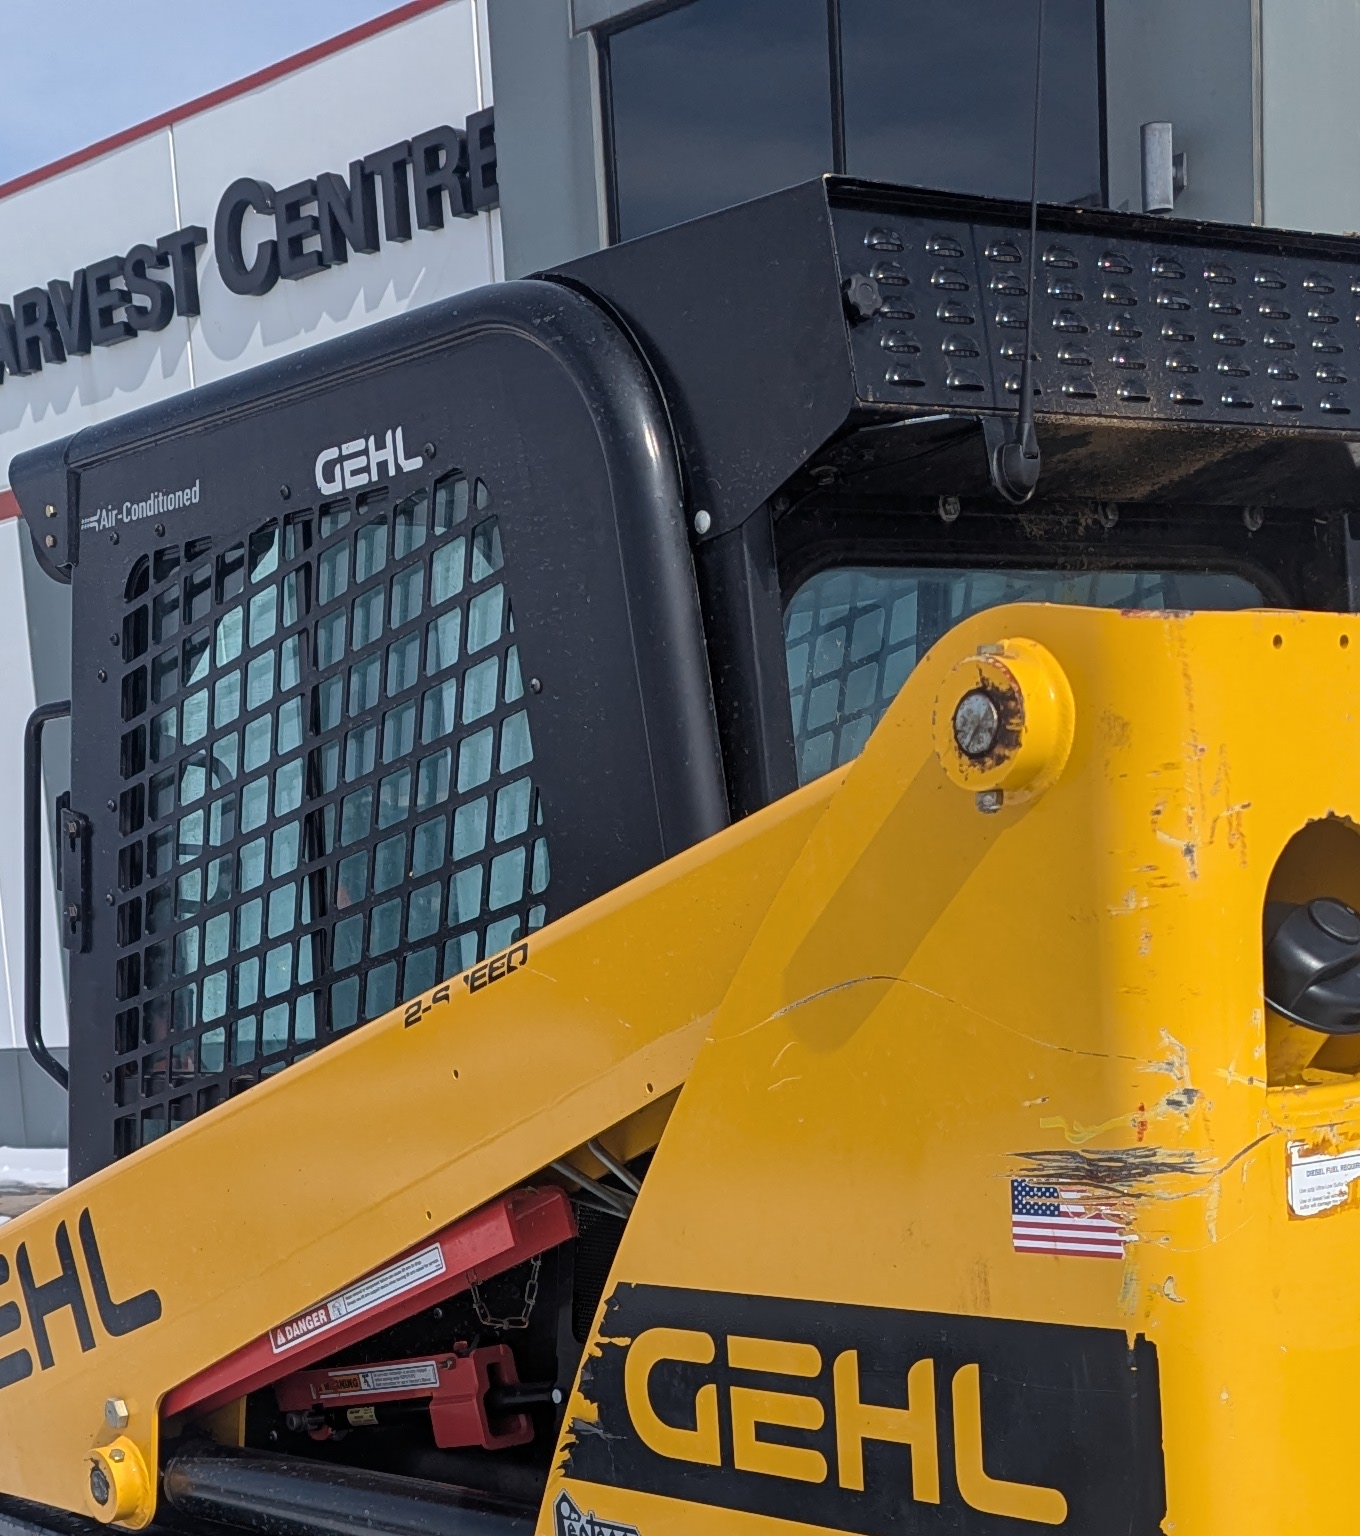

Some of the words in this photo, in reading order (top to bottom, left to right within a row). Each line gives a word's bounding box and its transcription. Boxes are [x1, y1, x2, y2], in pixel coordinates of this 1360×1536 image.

[214, 106, 500, 296] CENTRE
[315, 426, 423, 495] GEHL
[100, 479, 200, 530] Air-Conditioned
[1326, 1166, 1339, 1174] FUEL
[284, 1309, 328, 1340] DANGER
[624, 1326, 1068, 1525] GEHL
